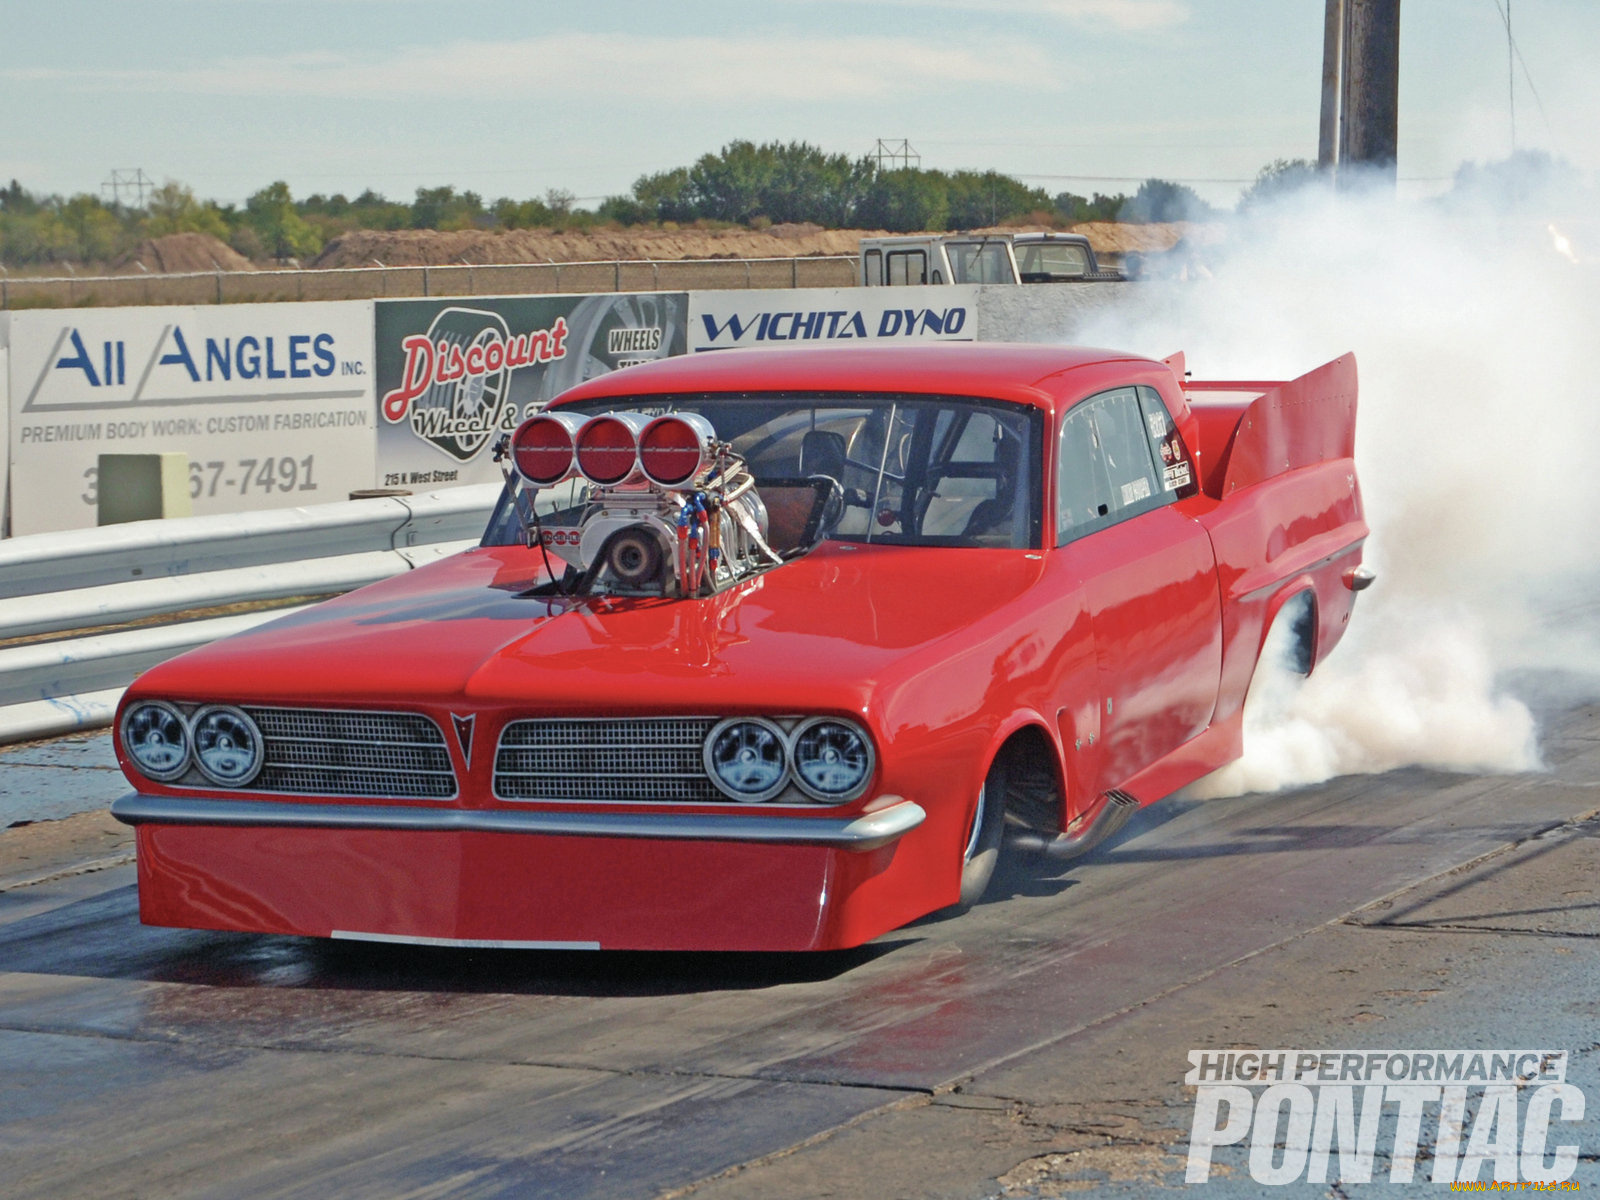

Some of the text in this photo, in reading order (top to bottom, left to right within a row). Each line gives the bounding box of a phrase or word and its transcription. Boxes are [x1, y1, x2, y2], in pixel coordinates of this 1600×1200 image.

[610, 329, 660, 352] WHEELS
[702, 308, 966, 341] WICHITA DYNO
[150, 324, 336, 385] ANGLES
[341, 361, 366, 376] INC.
[383, 318, 567, 423] Discount
[20, 424, 101, 443] PREMIUM
[106, 420, 149, 440] BODY
[206, 414, 270, 434] CUSTOM
[273, 410, 368, 431] FABRICATION
[414, 407, 492, 437] Wheel
[501, 405, 517, 431] &
[385, 472, 400, 486] 215
[410, 471, 431, 484] West
[433, 469, 458, 483] Street
